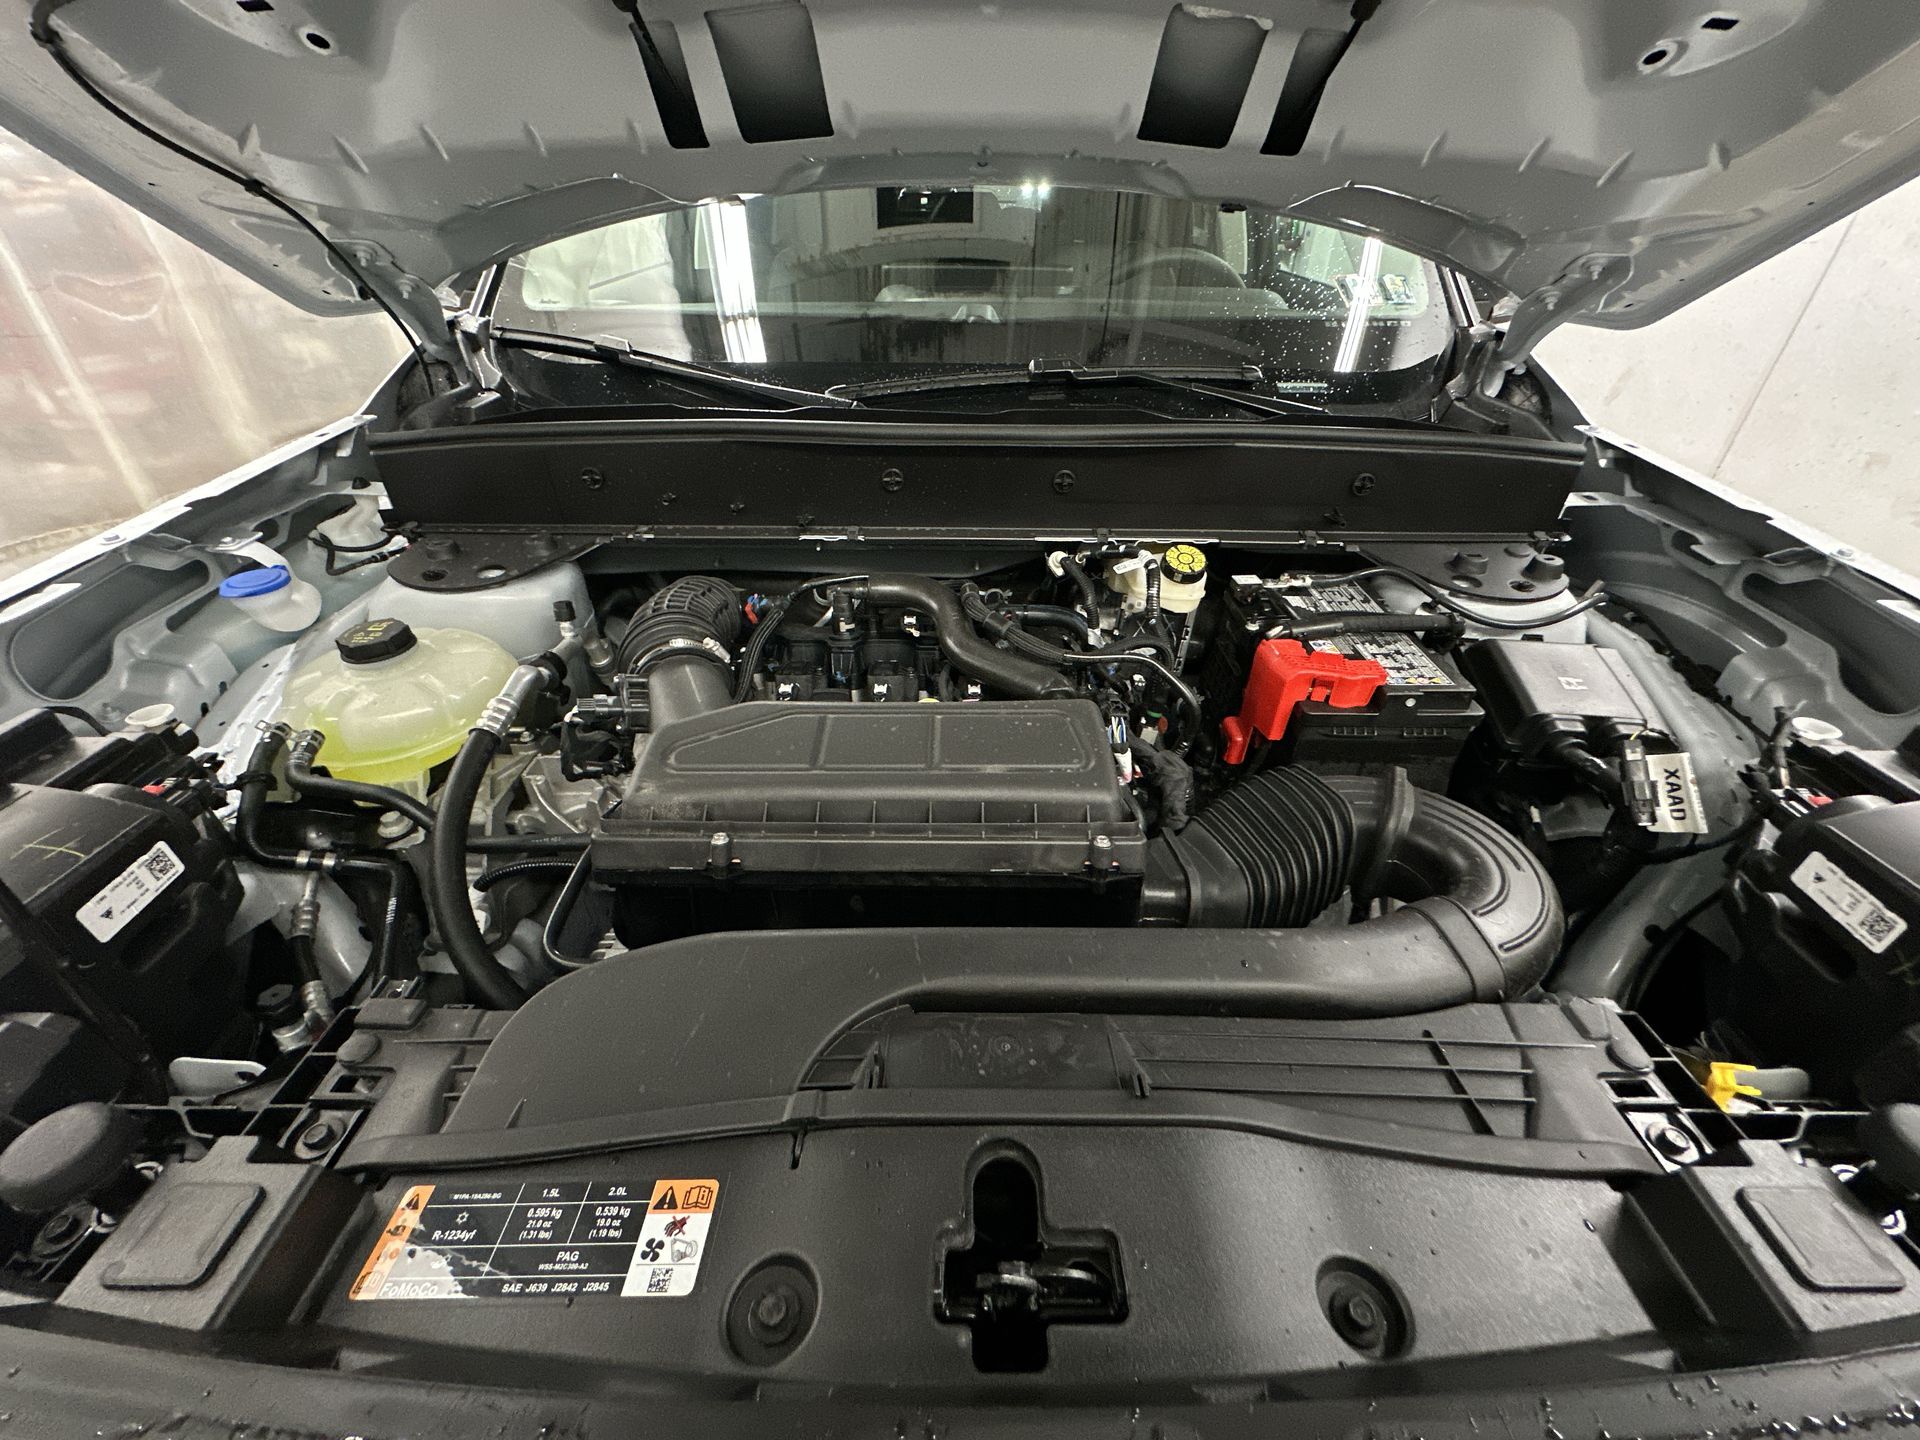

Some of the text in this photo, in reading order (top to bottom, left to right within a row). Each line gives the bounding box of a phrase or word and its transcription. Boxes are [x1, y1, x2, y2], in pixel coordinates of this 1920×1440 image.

[1663, 767, 1687, 821] XAAD
[542, 1188, 560, 1198] 1.5L
[608, 1186, 628, 1197] 2.0L
[527, 1208, 563, 1219] 0.595 kg
[595, 1206, 631, 1218] 0.539 kg
[526, 1220, 541, 1228] 21.0
[596, 1218, 610, 1226] 19.0
[432, 1230, 478, 1242] R-1234yf
[519, 1230, 553, 1240] (1.31 lbs)
[588, 1228, 623, 1239] (1.19 lbs)
[556, 1251, 580, 1261] PAG
[379, 1283, 439, 1297] FoMoCo
[501, 1282, 610, 1293] SAE J639 J2842 J2845
